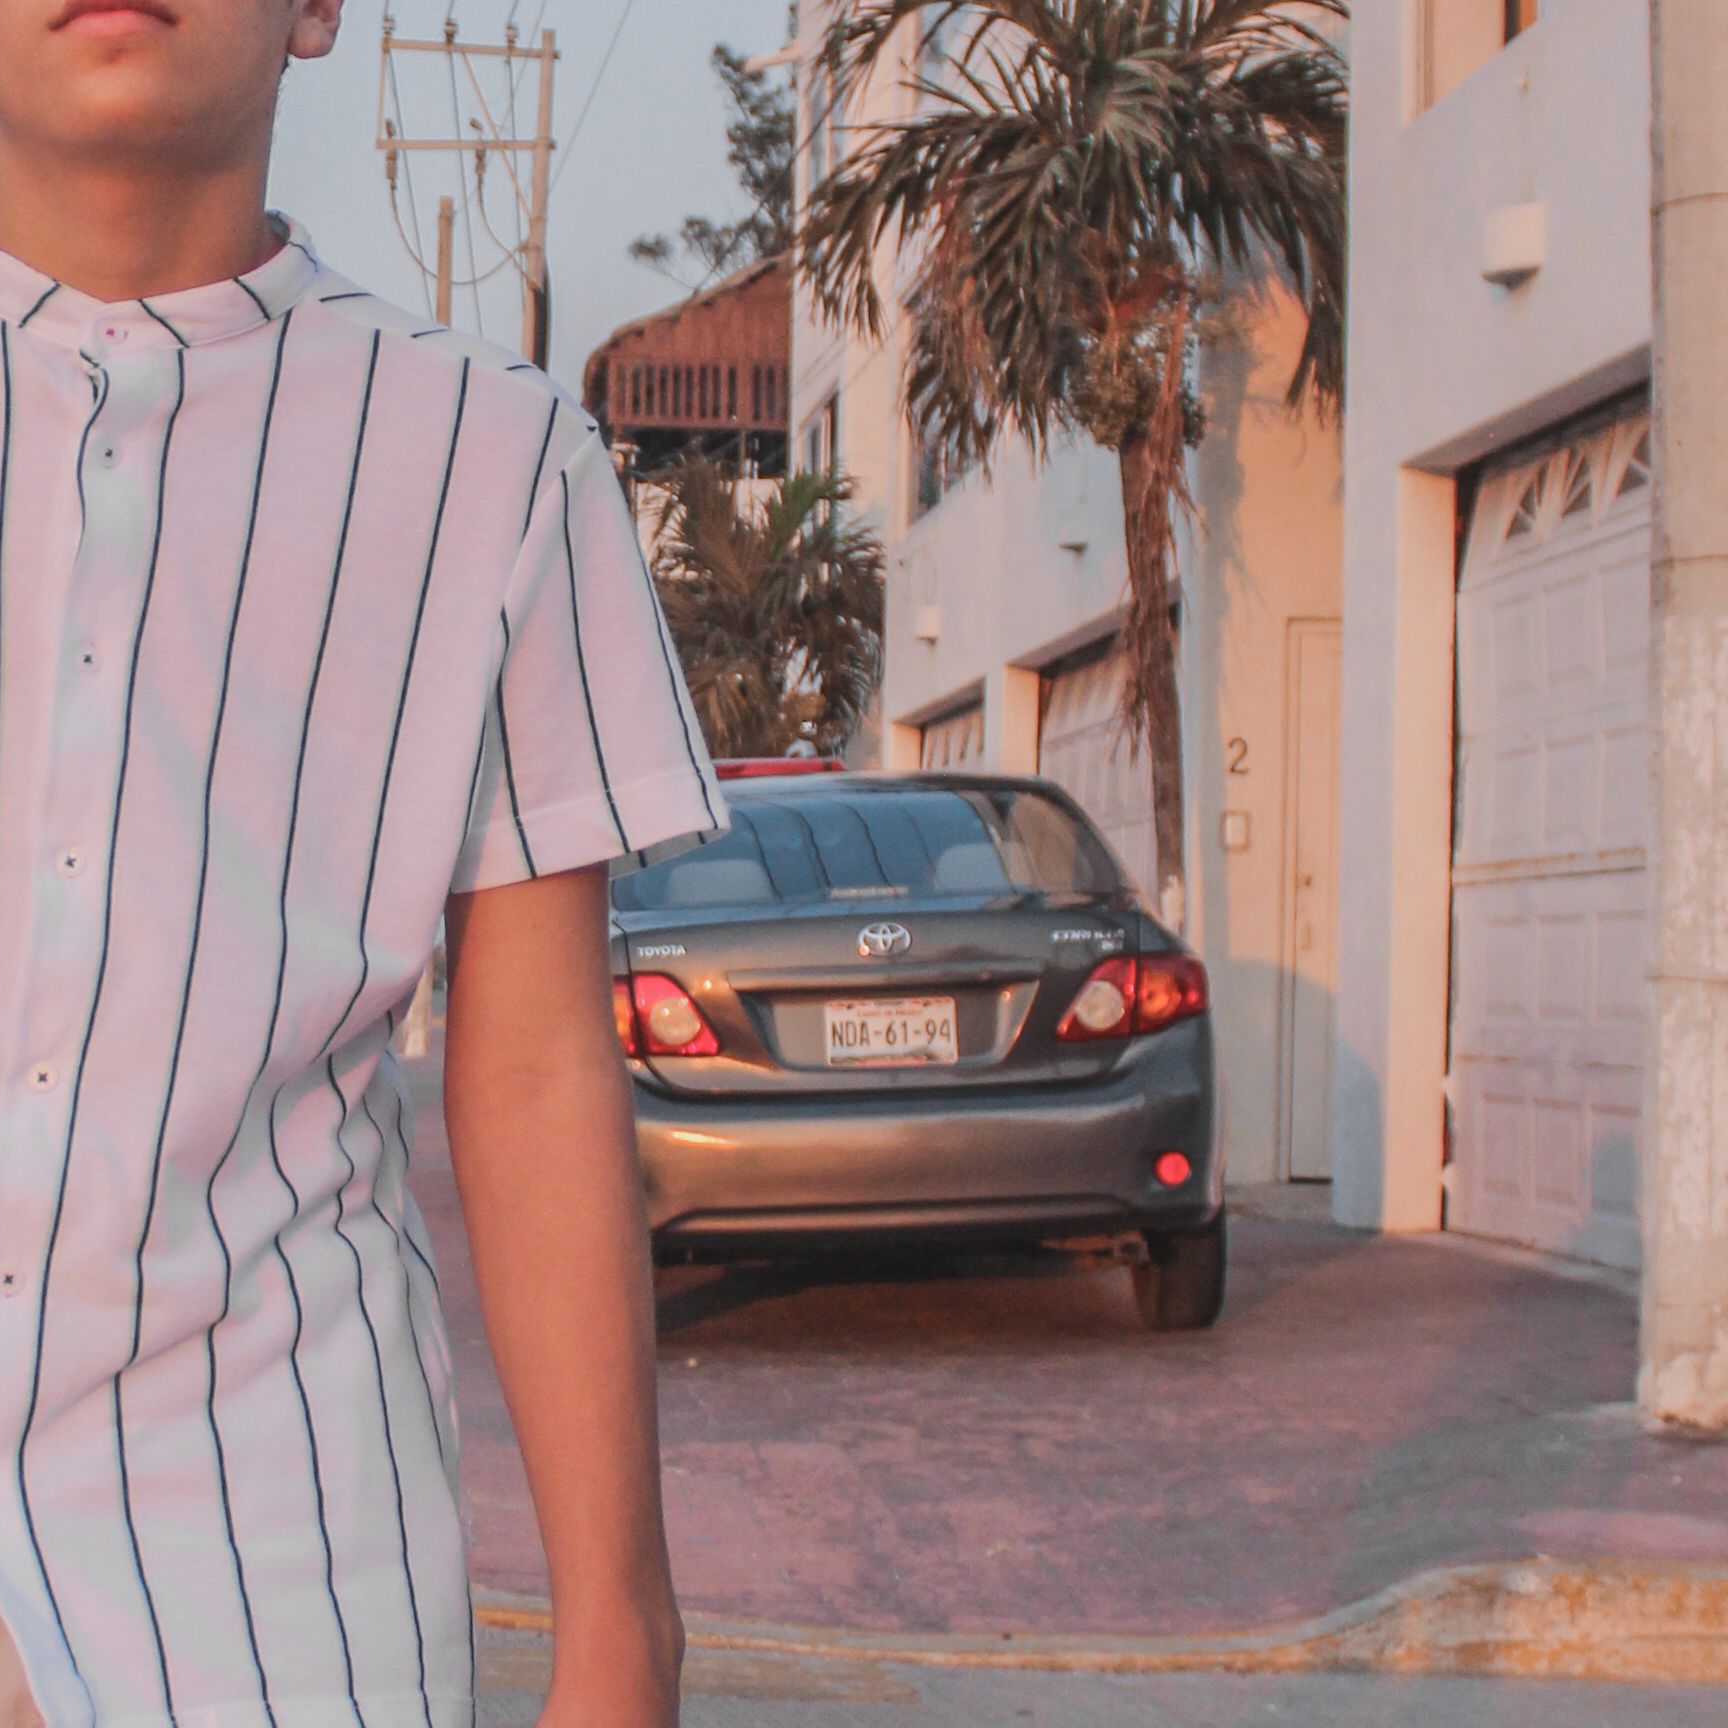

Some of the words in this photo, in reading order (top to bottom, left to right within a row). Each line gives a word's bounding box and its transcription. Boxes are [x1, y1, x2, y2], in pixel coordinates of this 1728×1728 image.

[1228, 737, 1249, 774] 2
[637, 944, 686, 957] TOYOTA
[831, 1019, 951, 1047] NDA-61-94
